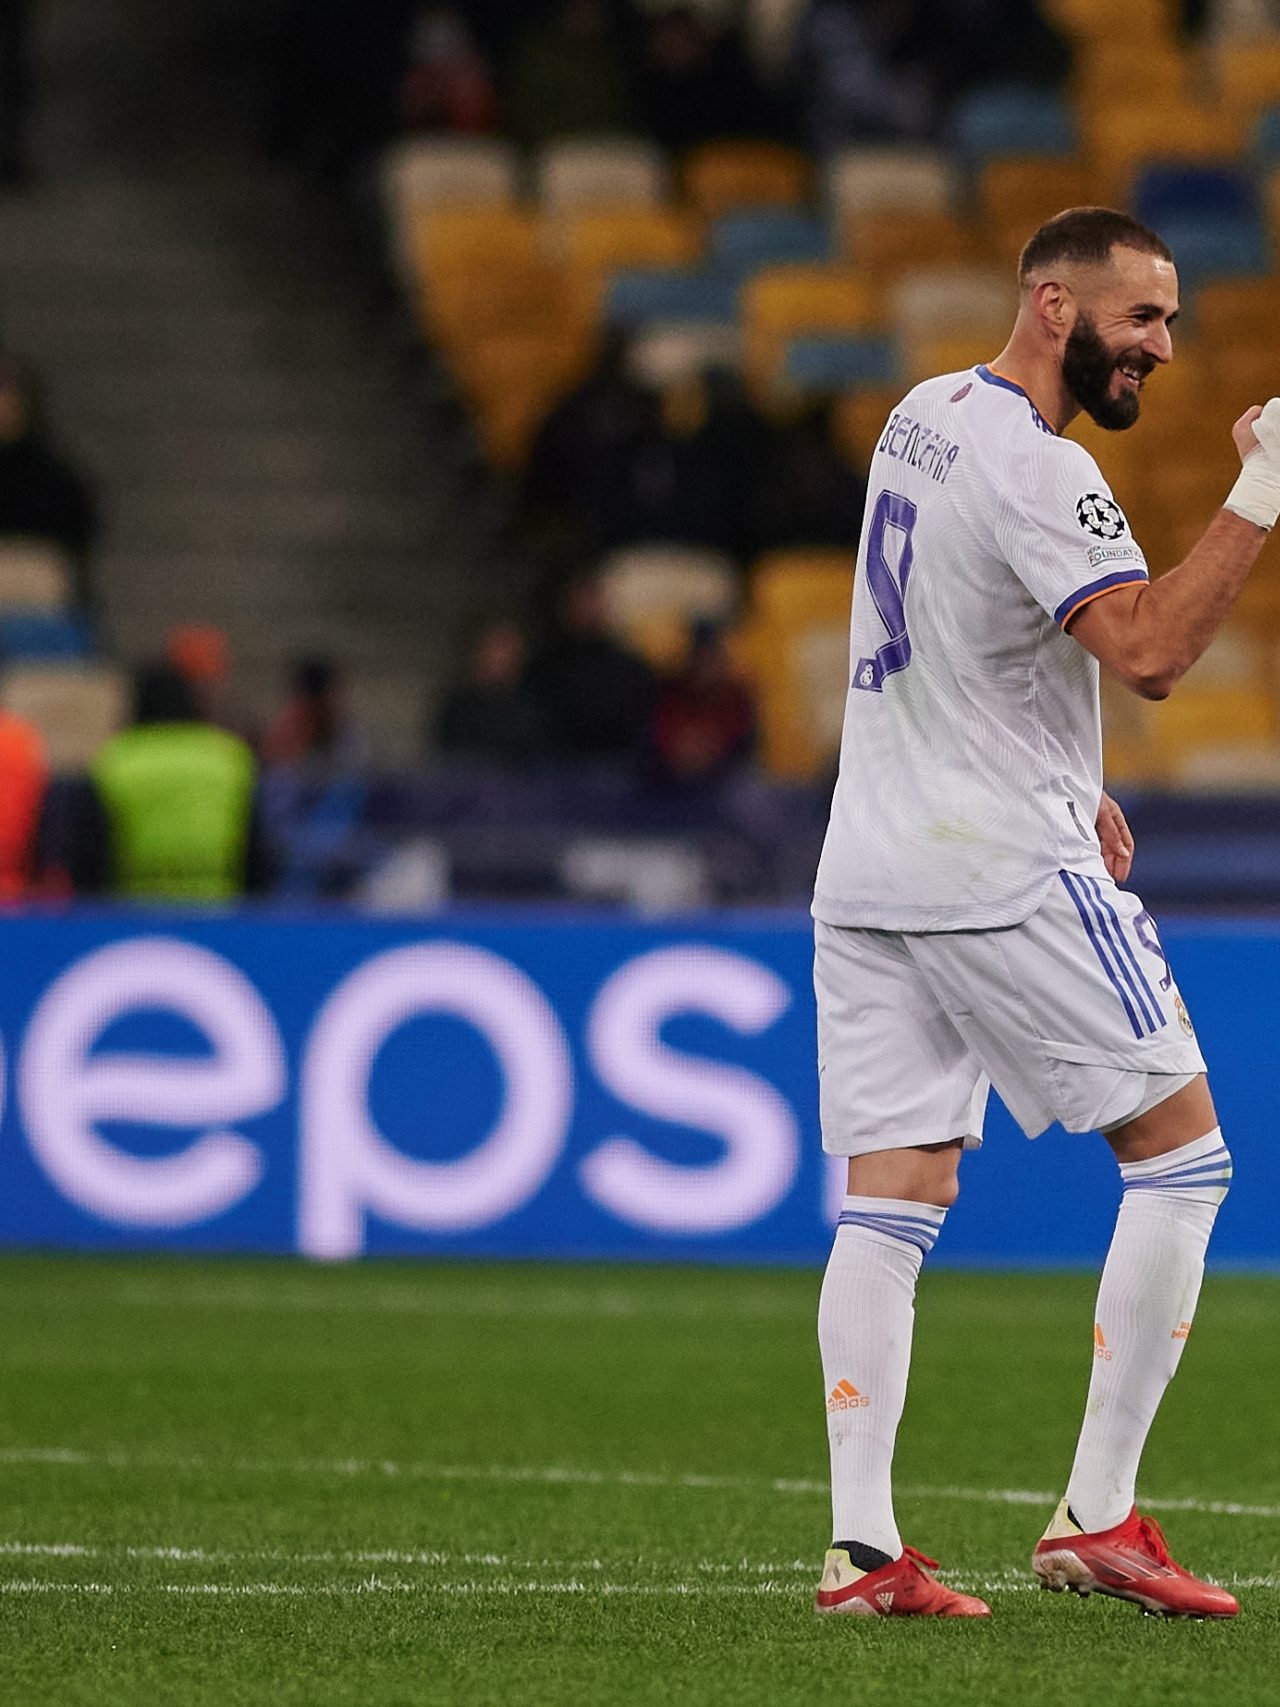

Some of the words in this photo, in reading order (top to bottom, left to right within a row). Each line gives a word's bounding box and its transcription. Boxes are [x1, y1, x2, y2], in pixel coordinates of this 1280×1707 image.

[852, 489, 918, 693] 9
[1088, 505, 1115, 526] 13
[0, 934, 848, 1263] eps
